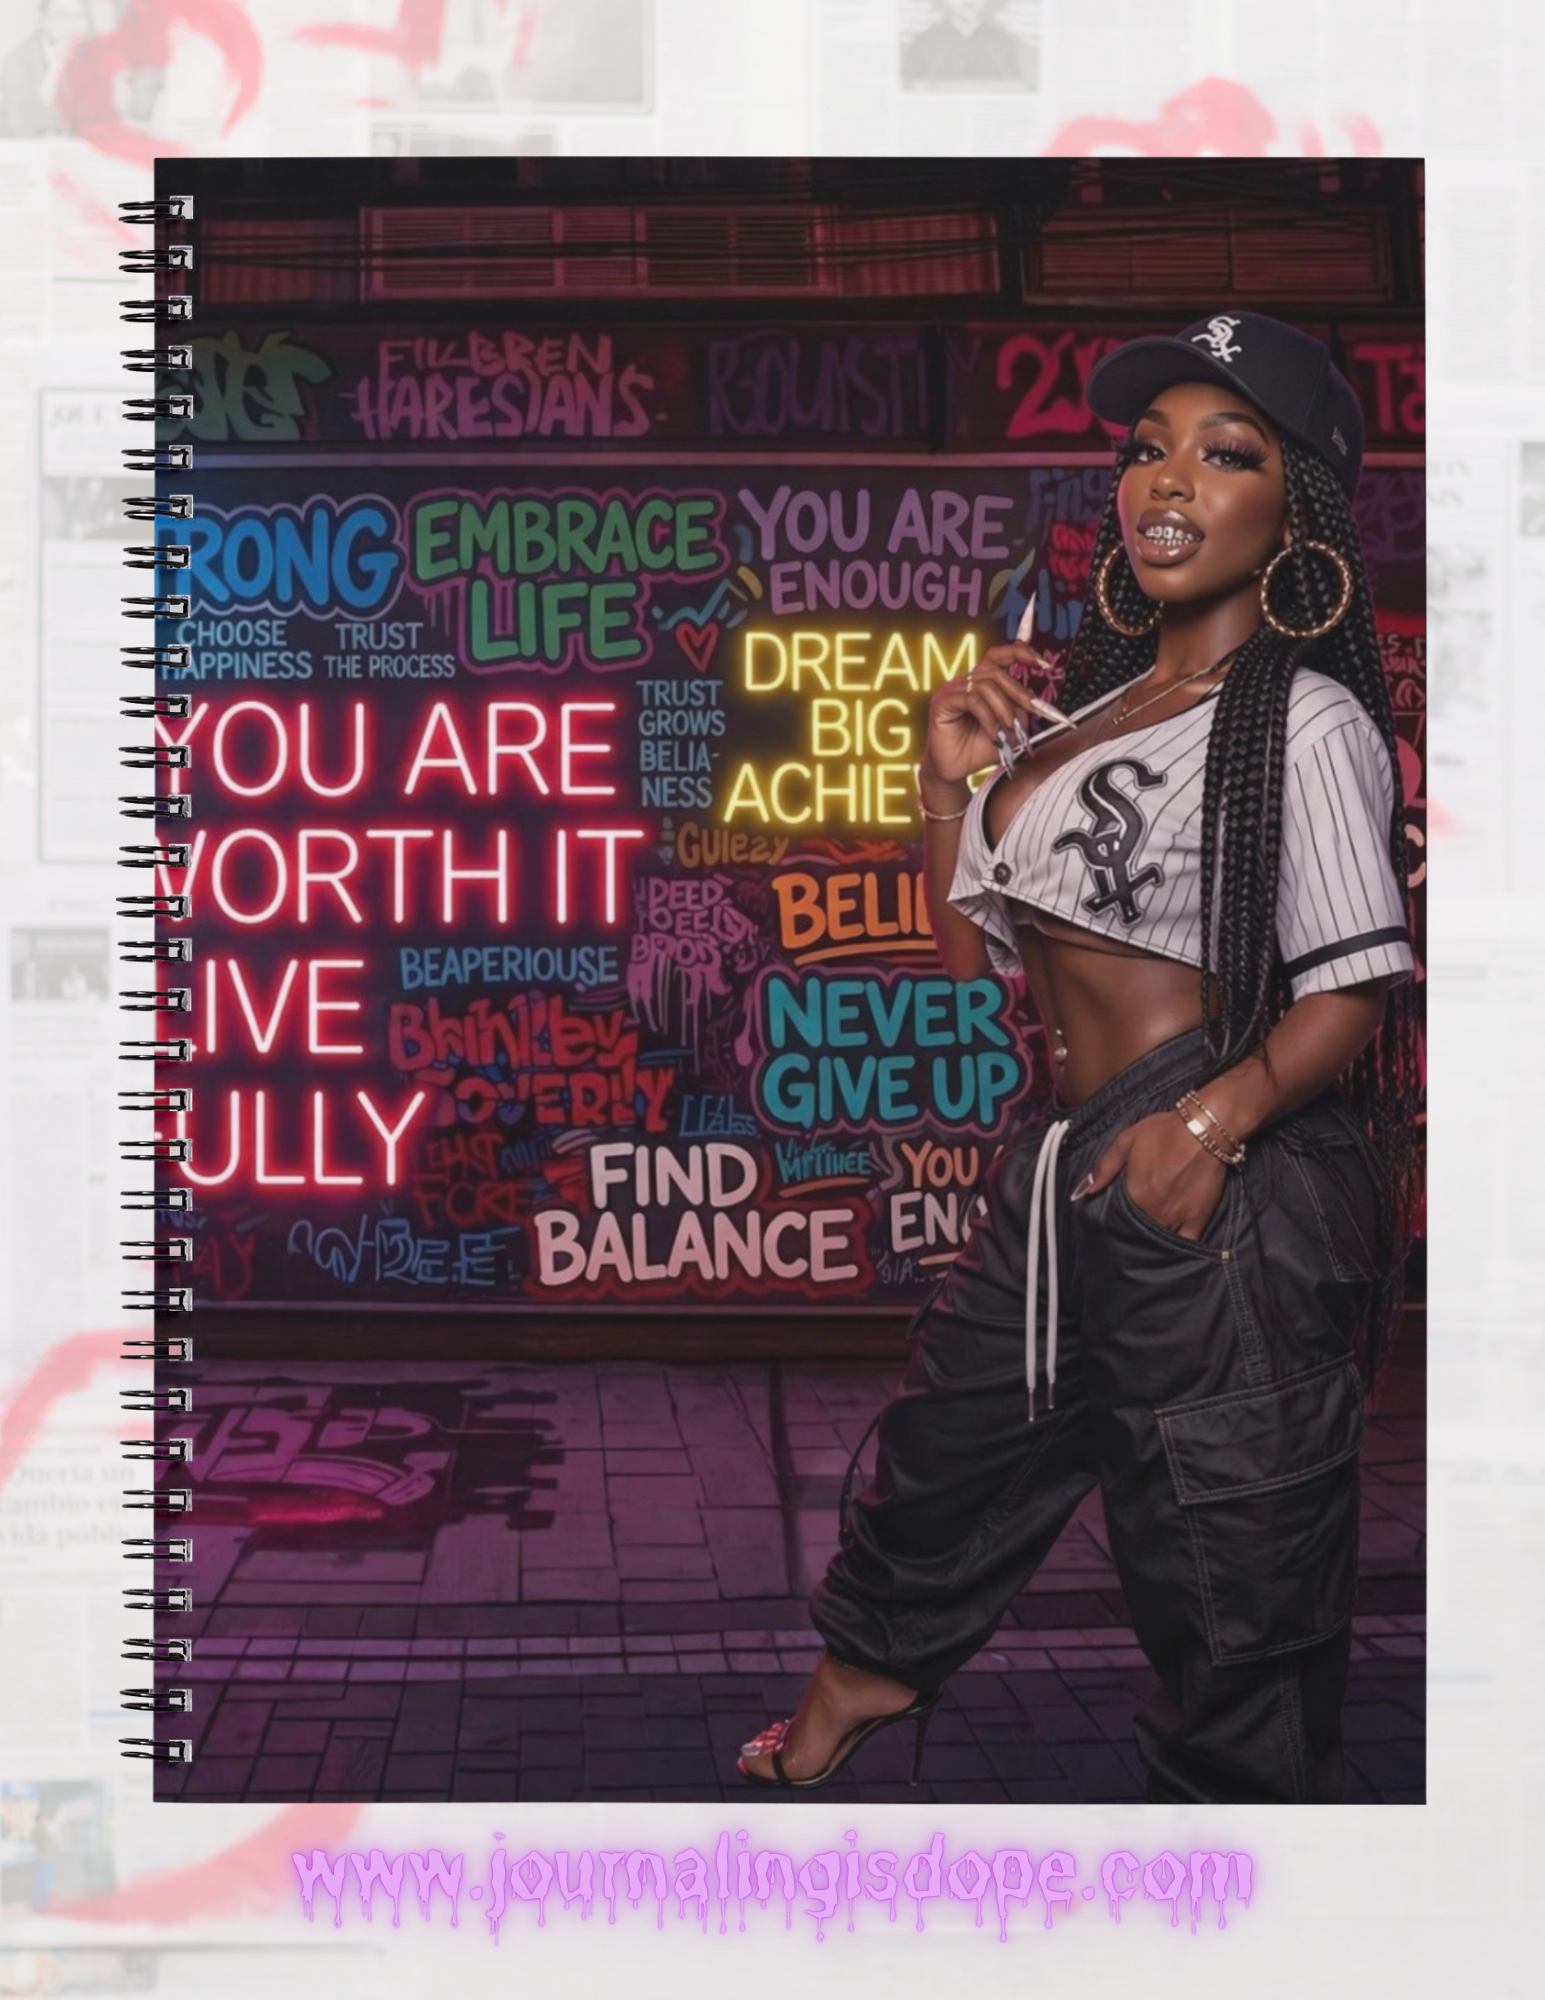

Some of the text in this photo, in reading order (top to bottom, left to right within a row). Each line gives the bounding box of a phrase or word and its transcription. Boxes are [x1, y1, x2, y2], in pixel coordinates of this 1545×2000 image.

[416, 499, 719, 581] EMBRACE
[738, 485, 870, 561] YOU
[887, 488, 1014, 559] ARE
[471, 579, 642, 661] LIFE
[769, 558, 982, 617] ENOUGH
[176, 619, 288, 647] CHOOSE
[334, 621, 424, 650] TRUST
[744, 632, 978, 692] DREAM
[323, 654, 456, 679] THE PROCESS
[636, 680, 723, 706] TRUST
[404, 702, 616, 796] ARE
[638, 709, 726, 737] GROWS
[811, 698, 912, 757] BIG
[641, 776, 713, 809] NESS
[723, 762, 997, 824] ACHIE
[556, 828, 646, 925] IT
[155, 958, 365, 1054] IVE
[767, 977, 1010, 1049] NEVER
[762, 1053, 919, 1129] GIVE
[931, 1053, 1020, 1126] UP
[155, 1089, 426, 1187] ULLY
[901, 1139, 979, 1189] YOU
[590, 1141, 759, 1209] FIND
[534, 1208, 859, 1286] BALANCE
